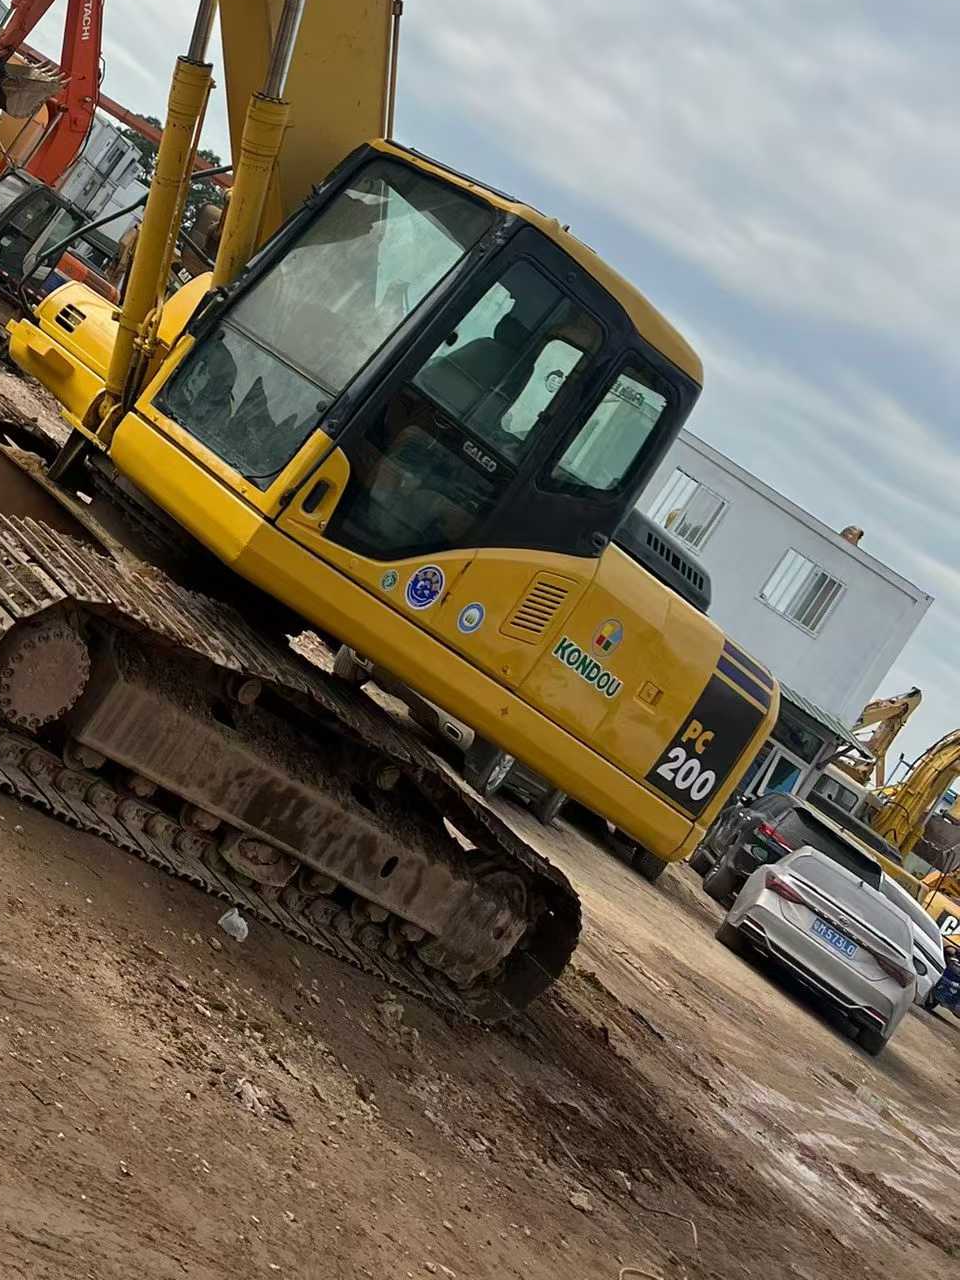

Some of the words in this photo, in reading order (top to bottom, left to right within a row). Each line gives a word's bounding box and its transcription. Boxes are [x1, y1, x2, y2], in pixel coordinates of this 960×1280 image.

[464, 441, 496, 472] GALEO
[553, 636, 623, 698] KONDOU
[681, 720, 715, 754] PC
[656, 747, 716, 800] 200
